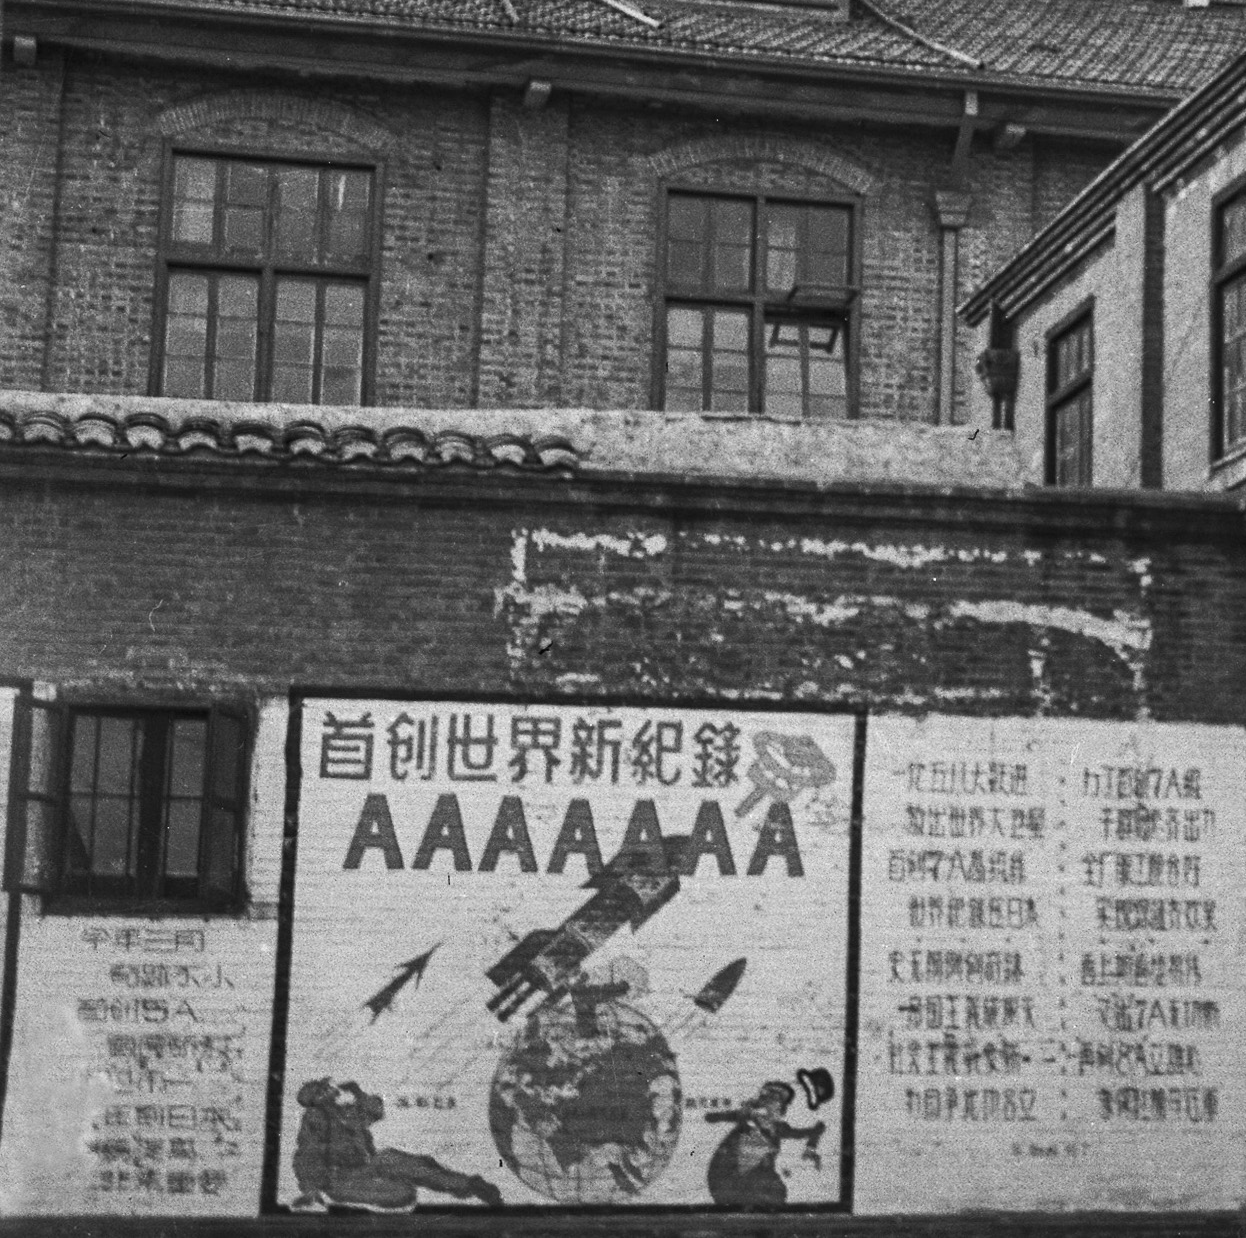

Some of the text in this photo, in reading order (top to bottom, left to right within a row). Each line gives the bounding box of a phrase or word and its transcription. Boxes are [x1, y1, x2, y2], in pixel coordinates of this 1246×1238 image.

[318, 710, 742, 789] 首创世界新紀錄
